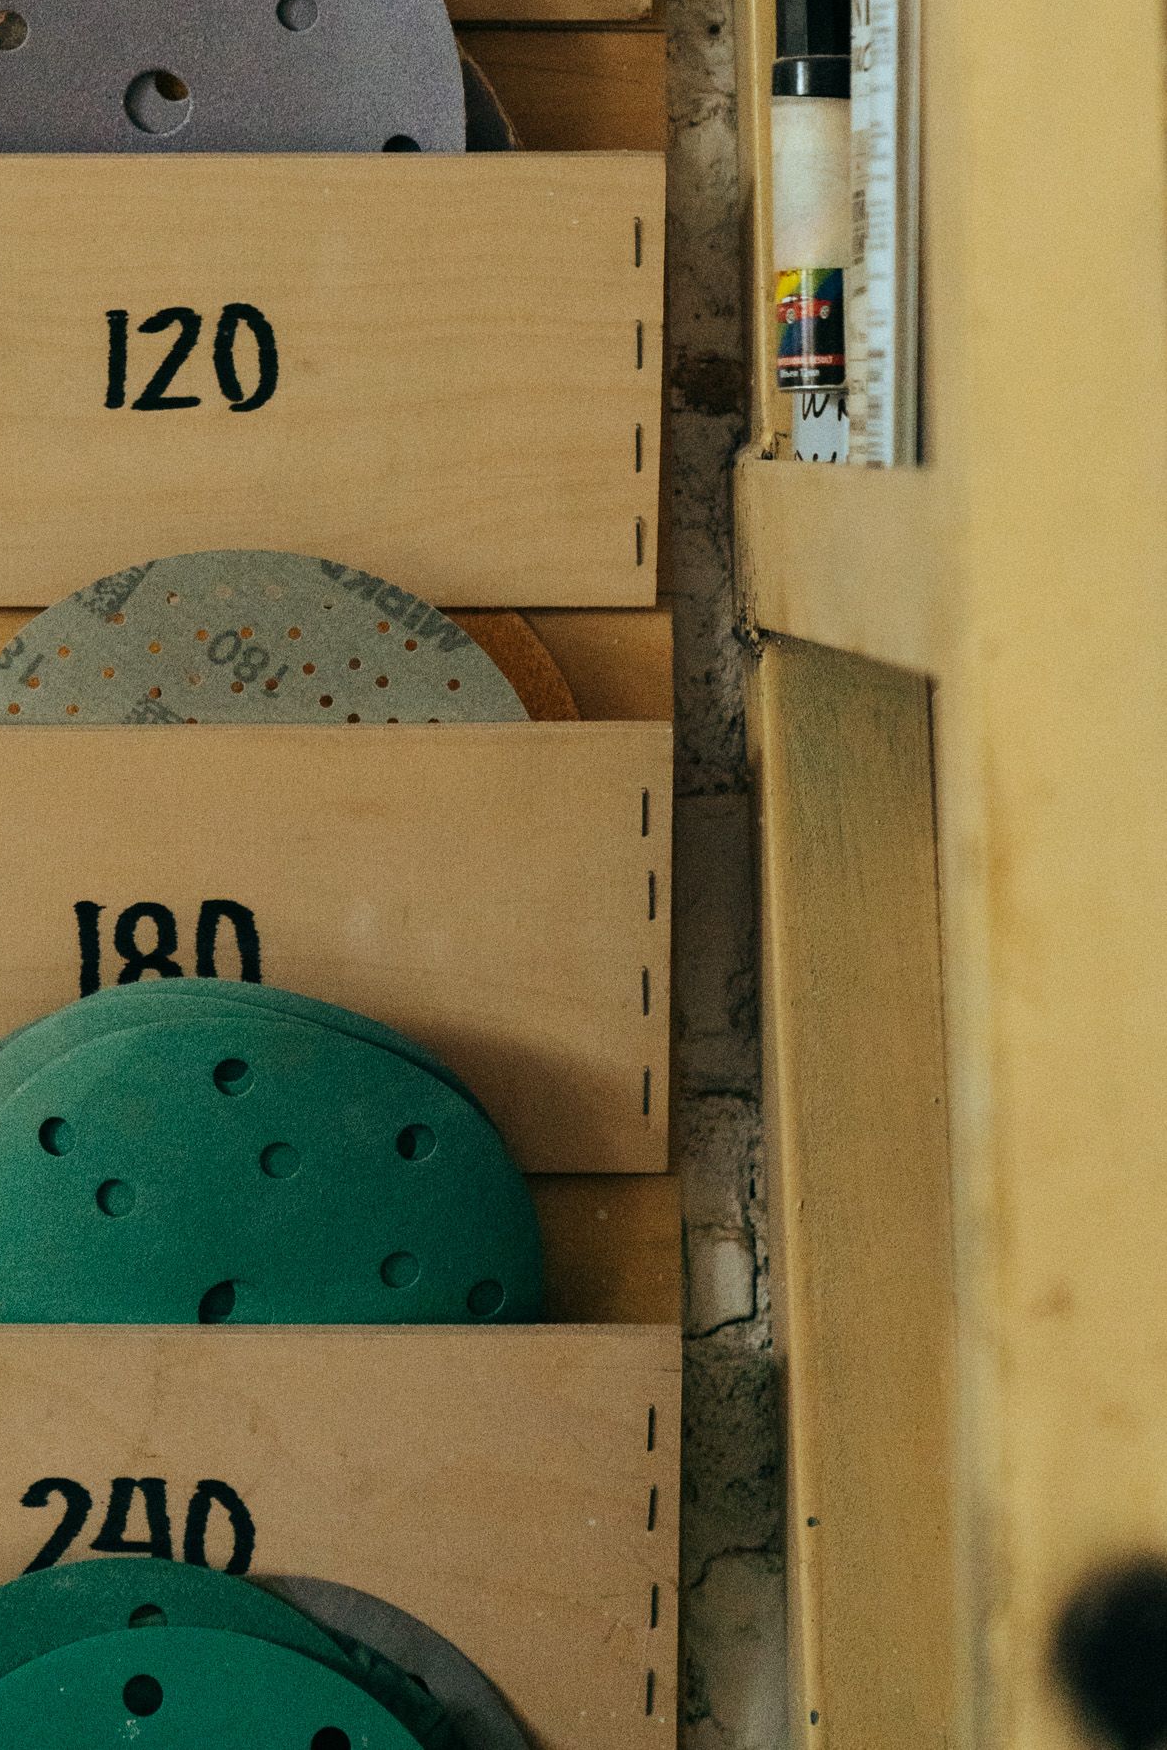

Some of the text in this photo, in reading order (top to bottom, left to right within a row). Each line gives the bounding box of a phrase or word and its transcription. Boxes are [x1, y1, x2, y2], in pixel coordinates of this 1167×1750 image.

[104, 302, 279, 413] 120
[207, 629, 291, 700] 180
[73, 898, 263, 997] 180
[19, 1476, 256, 1577] 240
